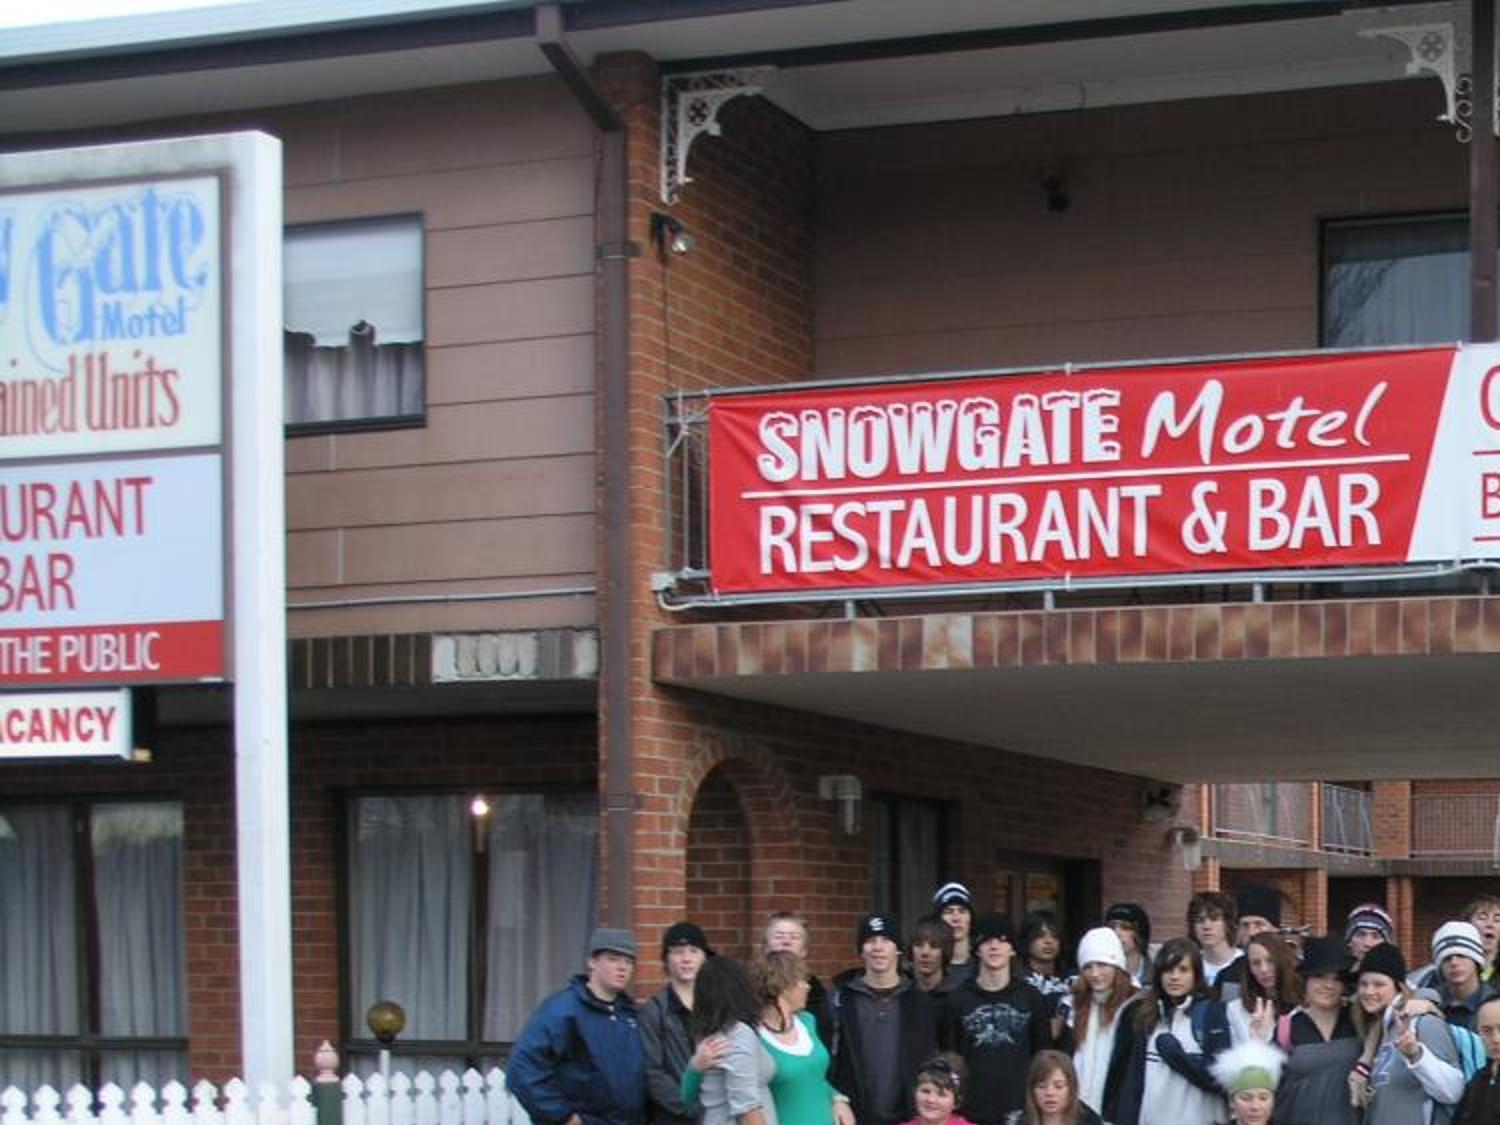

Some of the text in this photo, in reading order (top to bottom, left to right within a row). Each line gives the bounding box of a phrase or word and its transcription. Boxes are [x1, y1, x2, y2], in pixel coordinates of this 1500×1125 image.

[37, 187, 208, 346] Gate
[102, 296, 188, 341] Motel
[84, 349, 181, 430] Units
[757, 379, 1388, 482] SNOWGATE Motel
[0, 476, 153, 542] URANT
[759, 473, 1381, 575] RESTAURANT & BAR
[0, 553, 76, 612] BAR
[0, 632, 160, 674] THE PUBLIC
[0, 706, 116, 743] CANCY
